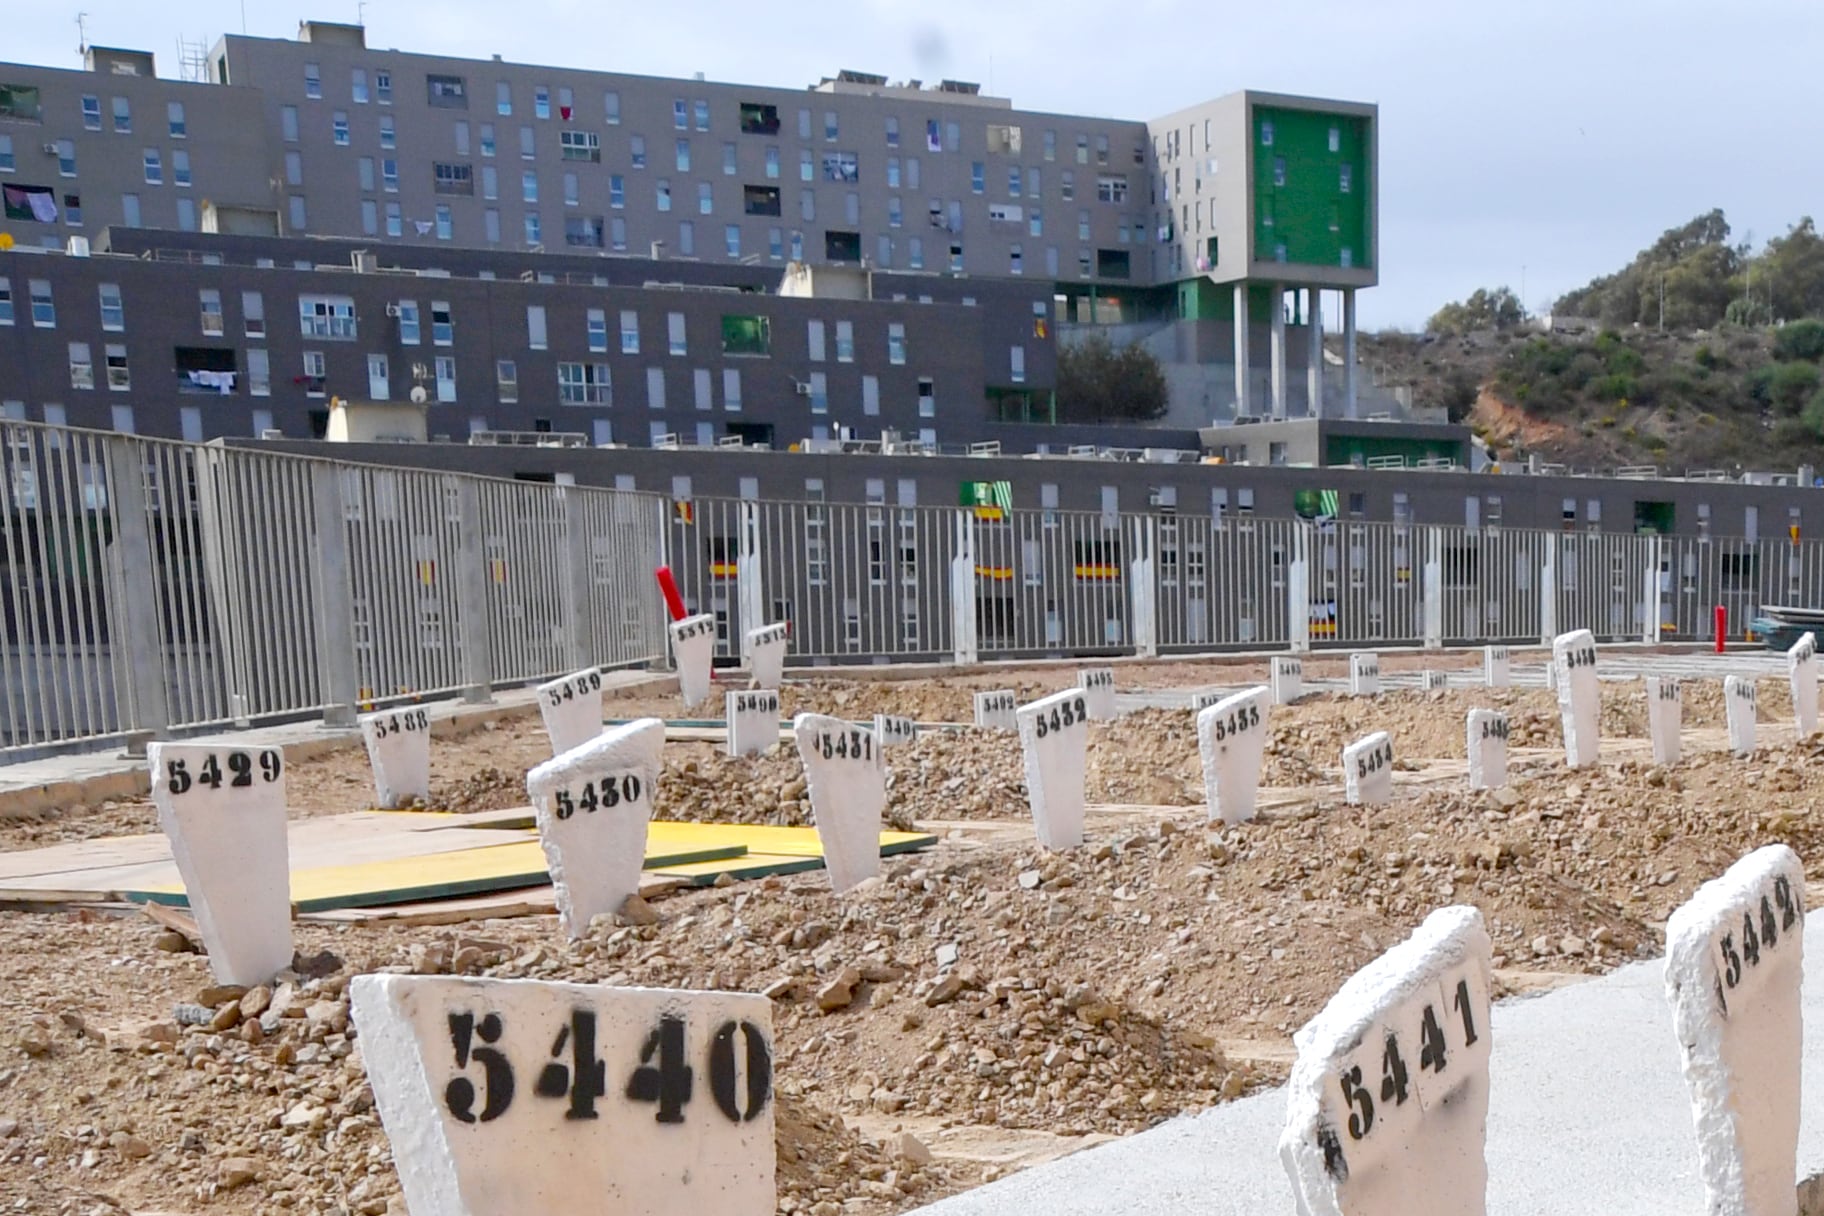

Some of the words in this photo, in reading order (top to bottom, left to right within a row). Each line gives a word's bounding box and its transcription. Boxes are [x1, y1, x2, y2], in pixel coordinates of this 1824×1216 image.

[549, 671, 602, 707] 5489
[374, 709, 428, 740] 5488
[1036, 697, 1086, 739] 5432
[1216, 705, 1260, 741] 5433
[822, 730, 872, 761] 5431
[1358, 742, 1392, 778] 5434
[168, 750, 281, 794] 5429
[555, 774, 641, 820] 5430
[446, 1007, 771, 1124] 5440
[1340, 979, 1478, 1140] 5441
